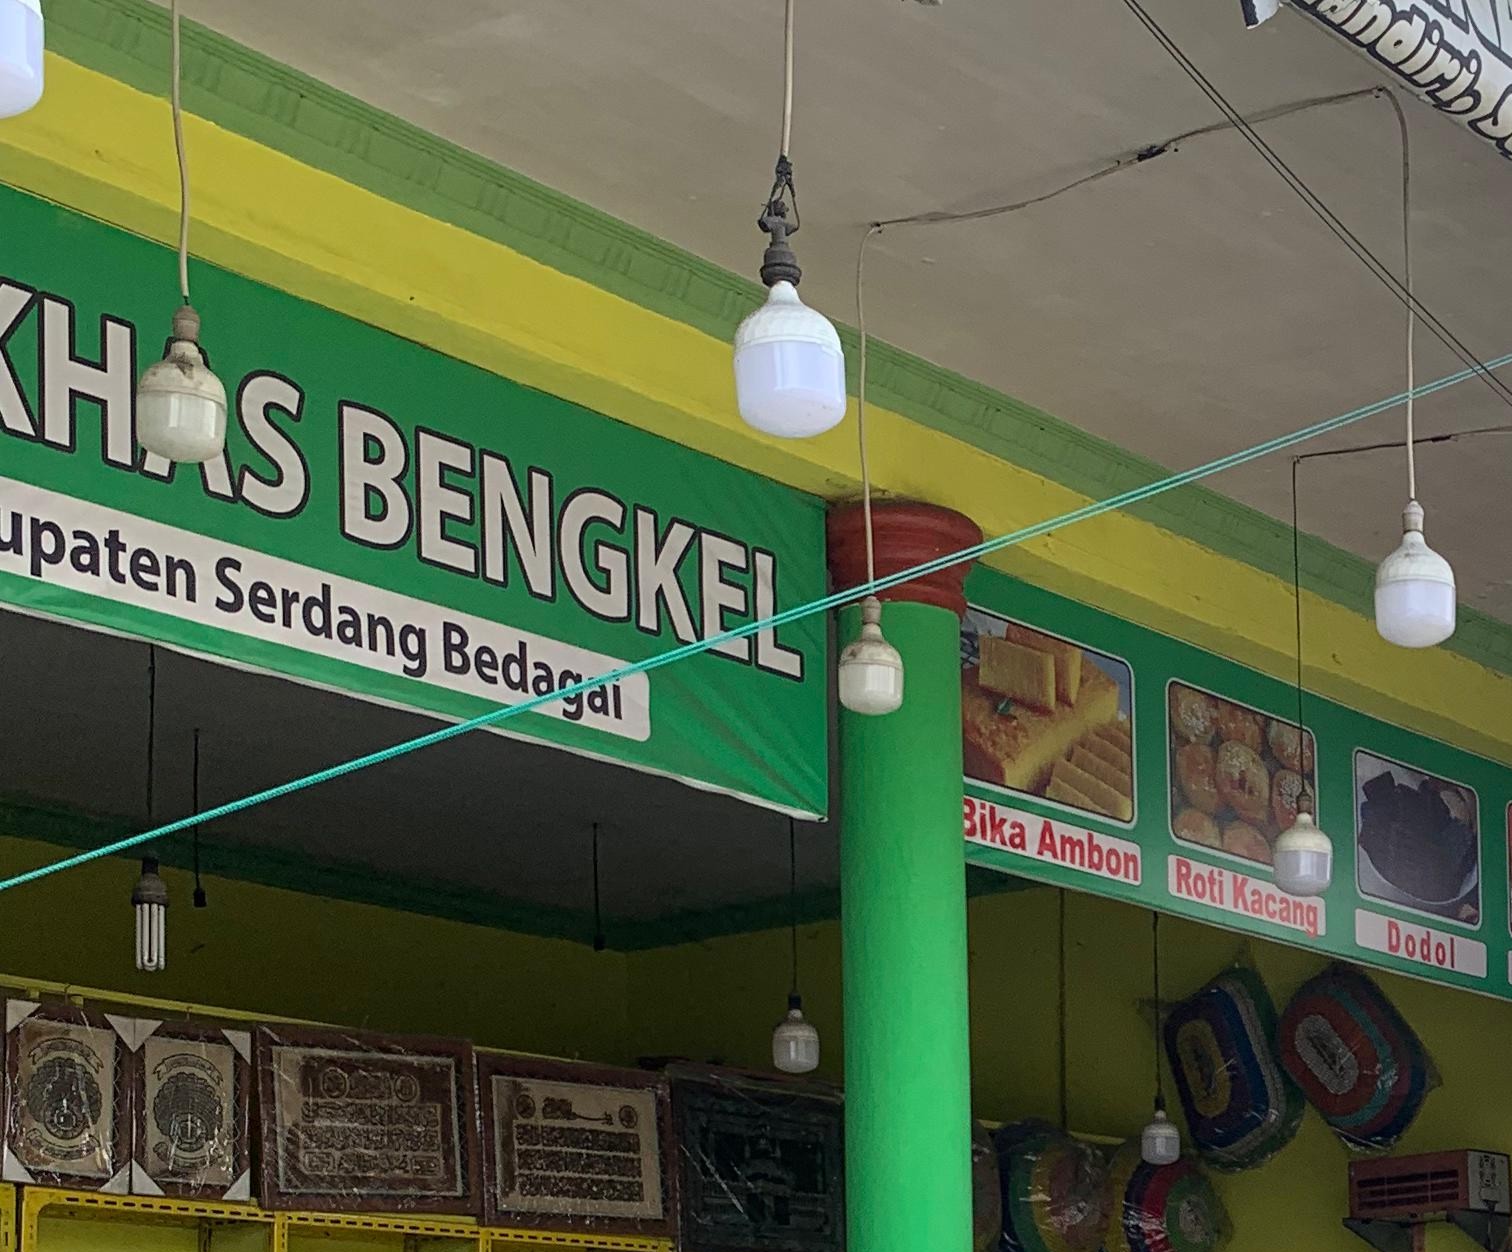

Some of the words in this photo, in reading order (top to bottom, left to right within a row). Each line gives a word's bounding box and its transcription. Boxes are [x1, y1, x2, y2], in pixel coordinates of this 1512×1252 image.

[1290, 0, 1482, 116] andiri,
[0, 275, 311, 520] KHS
[337, 399, 804, 683] BENGKEL
[214, 556, 428, 678] Serdang
[441, 626, 624, 723] Bedagai
[963, 798, 1026, 850] Bika
[1037, 820, 1139, 882] Ambon
[1175, 857, 1224, 906] Roti
[1232, 873, 1318, 939] Kacang
[1387, 920, 1455, 969] Dodol
